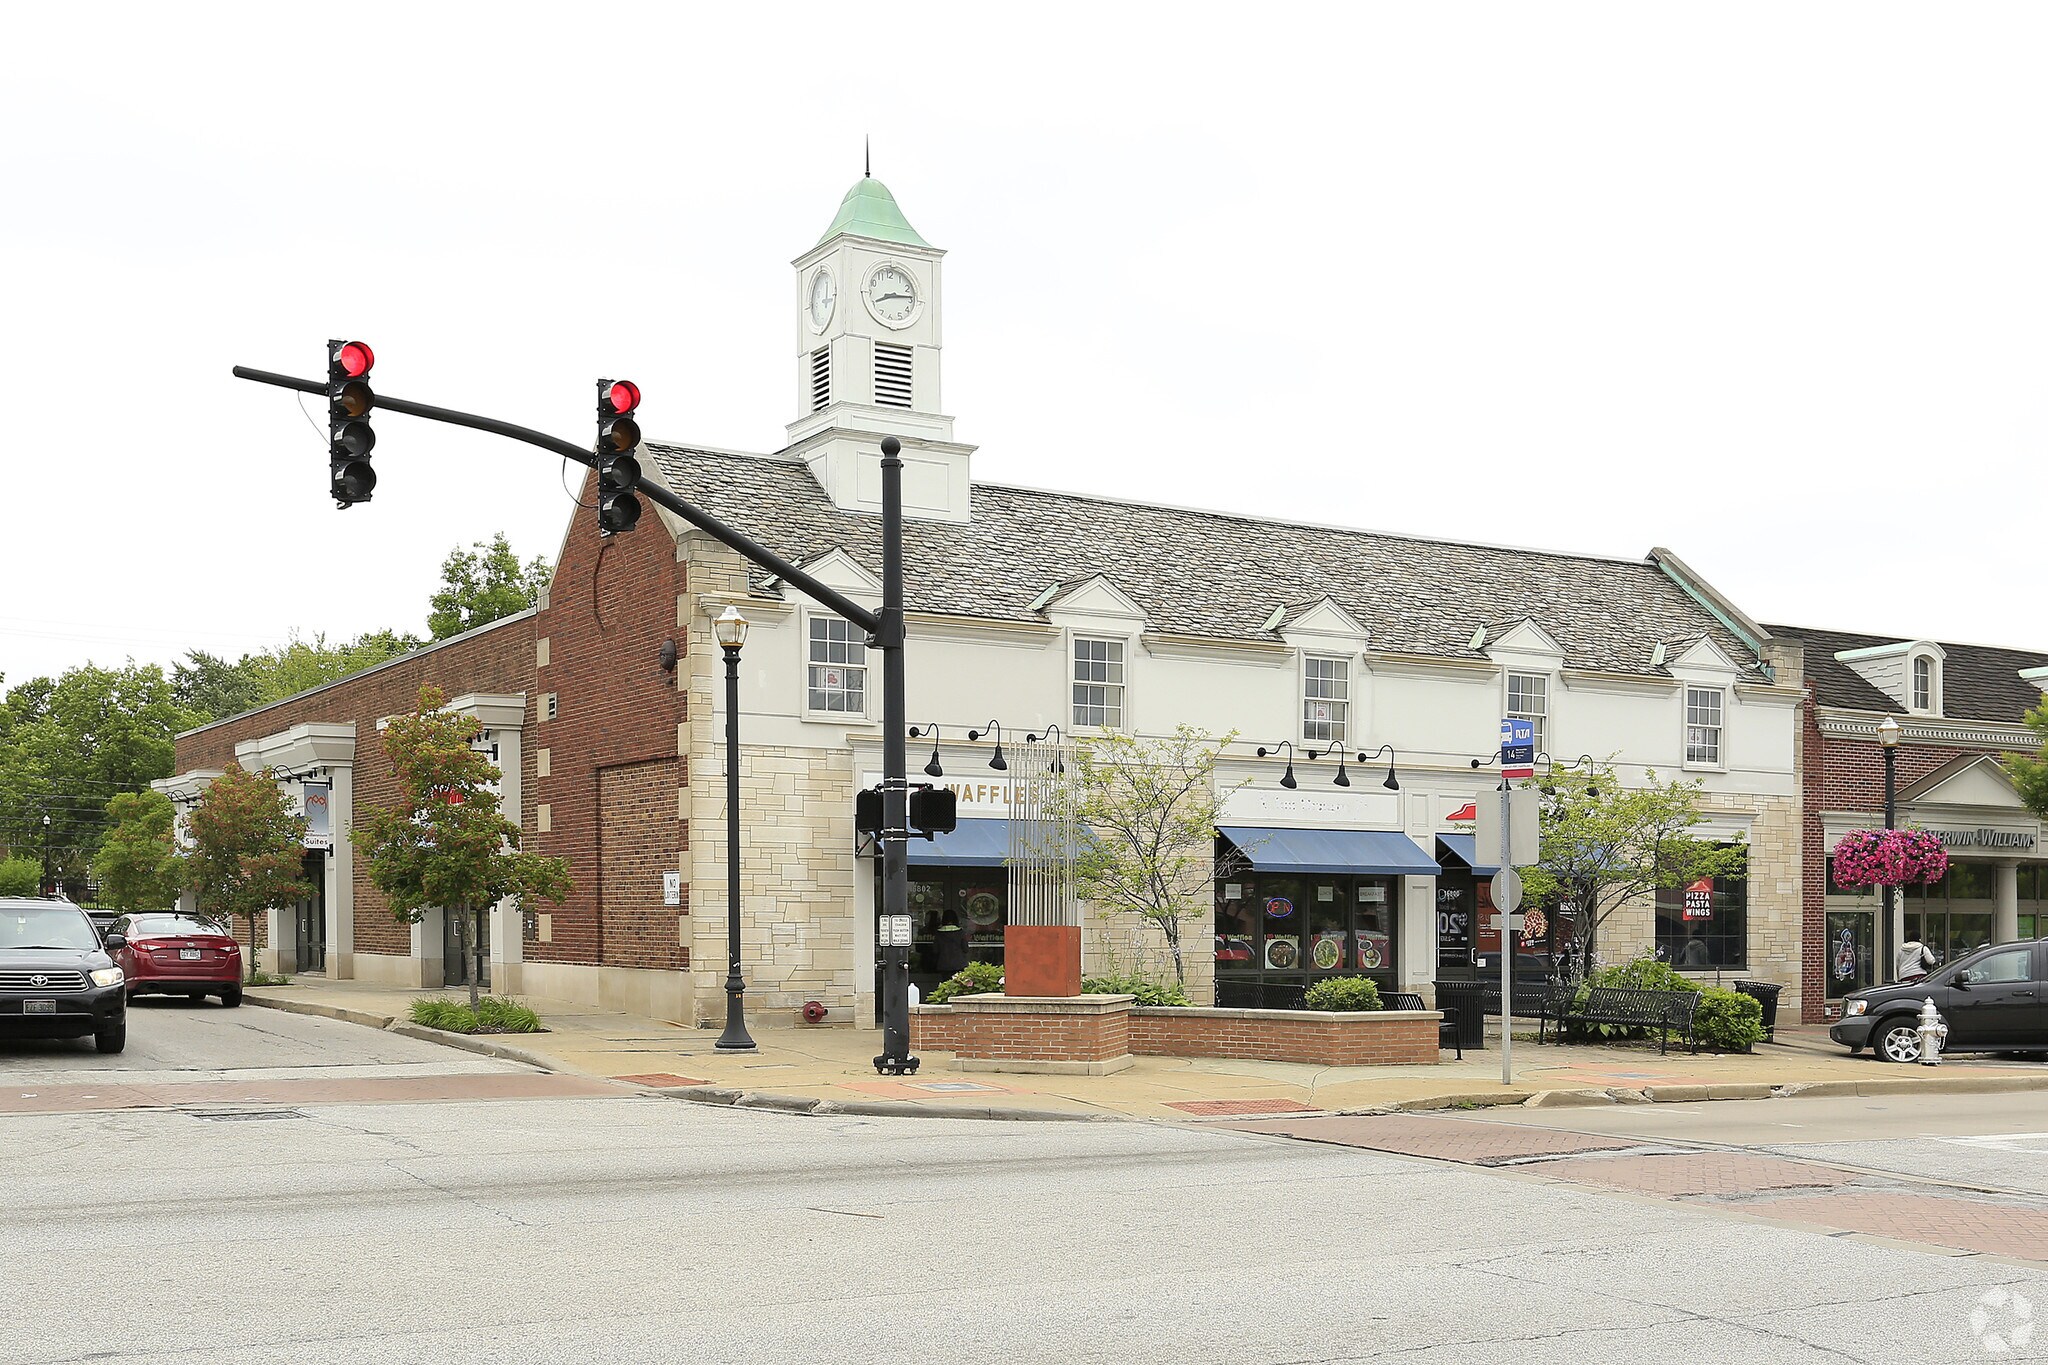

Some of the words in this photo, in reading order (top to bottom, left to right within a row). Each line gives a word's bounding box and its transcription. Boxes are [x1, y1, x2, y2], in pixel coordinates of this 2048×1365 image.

[887, 271, 893, 279] 12
[1515, 729, 1530, 739] RTA
[945, 784, 1040, 805] WAFFLES
[1685, 892, 1710, 900] PIZZA
[1685, 900, 1710, 908] PASTA
[1686, 908, 1711, 916] WINGS
